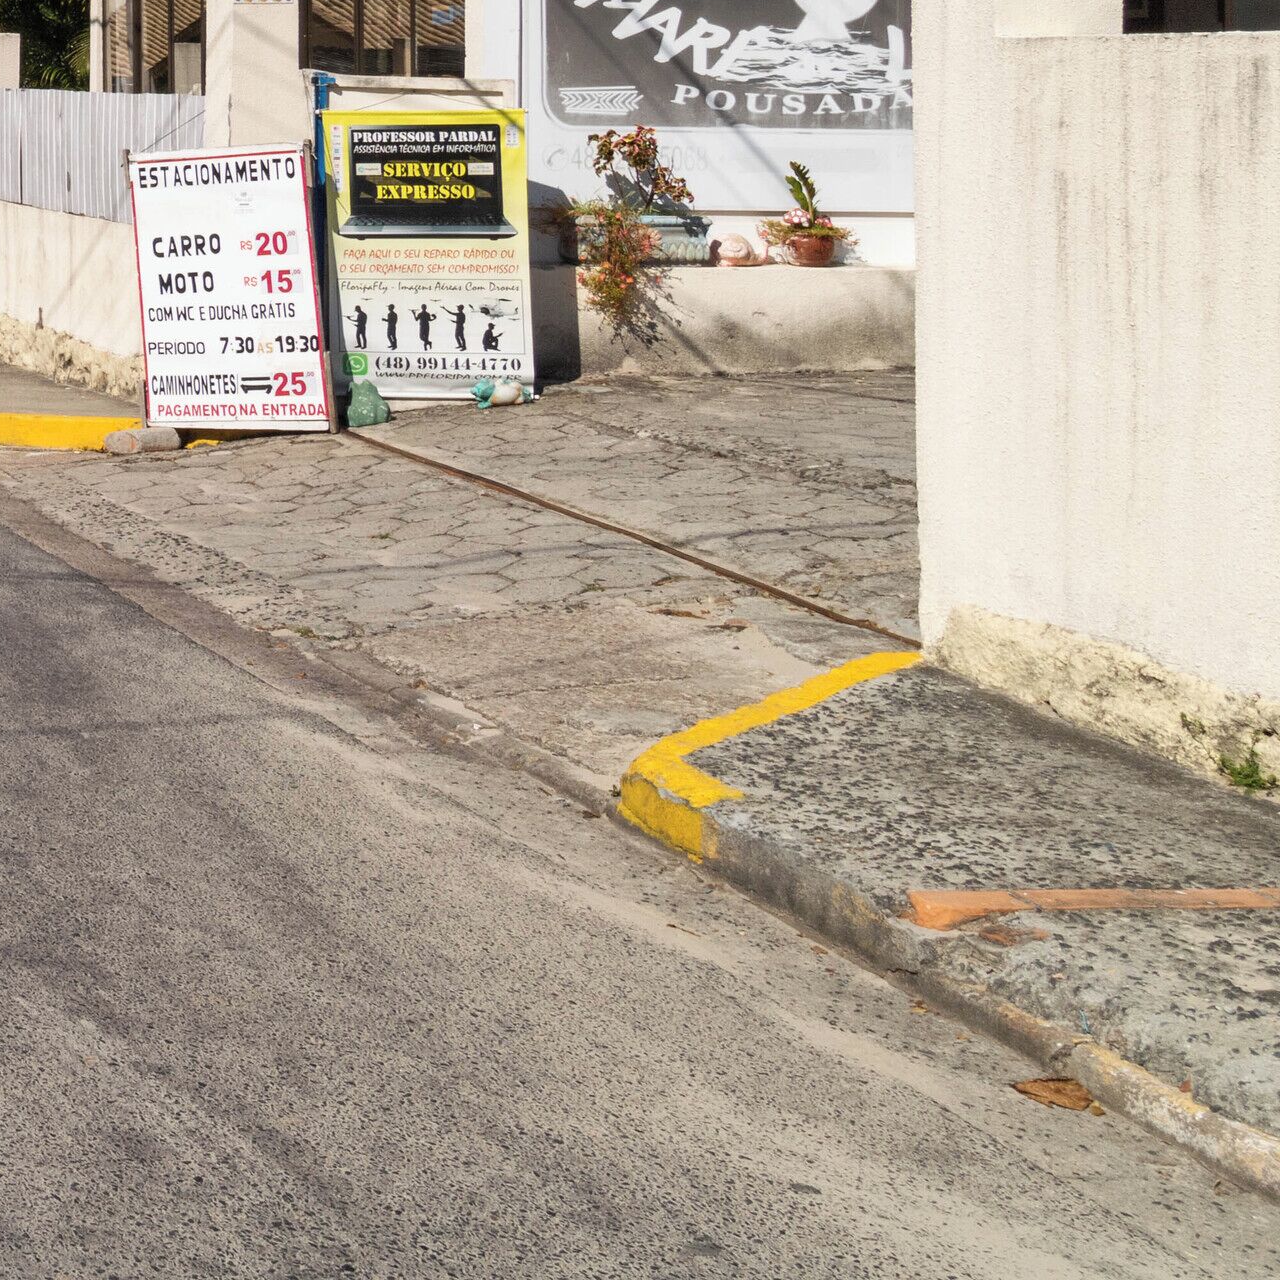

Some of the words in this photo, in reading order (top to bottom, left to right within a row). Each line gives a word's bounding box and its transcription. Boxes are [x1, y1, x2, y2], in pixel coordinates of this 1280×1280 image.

[353, 131, 436, 143] PROFESSOR
[438, 130, 496, 142] PARDAL
[353, 143, 398, 154] ASSISTÊNCIA
[399, 143, 431, 154] TÉCNICA
[432, 144, 444, 153] EM
[446, 142, 496, 153] INFORMÁTICA
[139, 157, 295, 189] ESTACIONAMENTO
[383, 161, 466, 182] SERVIÇO
[376, 184, 476, 200] EXPRESSO
[153, 233, 221, 258] CARRO
[343, 249, 367, 260] FAÇA
[368, 249, 391, 259] AQUI
[394, 250, 400, 259] O
[403, 249, 421, 258] SEU
[423, 249, 460, 258] REPARO
[463, 247, 497, 258] RÁPIDO
[500, 249, 515, 258] OU
[339, 264, 347, 273] O
[349, 264, 366, 273] SEU
[368, 264, 424, 275] ORÇAMENTO
[426, 264, 446, 274] SEM
[448, 264, 520, 274] COMPROMISSO!
[158, 270, 215, 295] MOTO
[340, 281, 388, 296] FloripaFly
[398, 281, 432, 295] Imagens
[434, 280, 461, 292] Aéreas
[465, 281, 486, 291] Com
[489, 281, 520, 292] Drones
[148, 306, 173, 322] COM
[176, 306, 195, 321] WC
[199, 306, 206, 321] E
[209, 304, 248, 320] DUCHA
[251, 301, 295, 319] GRÁTIS
[148, 338, 206, 355] PERÍODO
[220, 336, 255, 354] 7:30
[275, 334, 320, 353] 19:30
[375, 356, 411, 371] (48)
[417, 357, 522, 371] 99144-4770
[152, 374, 237, 396] CAMINHONETES
[158, 404, 237, 418] PAGAMENTO
[239, 404, 258, 416] NA
[263, 403, 326, 417] ENTRADA
